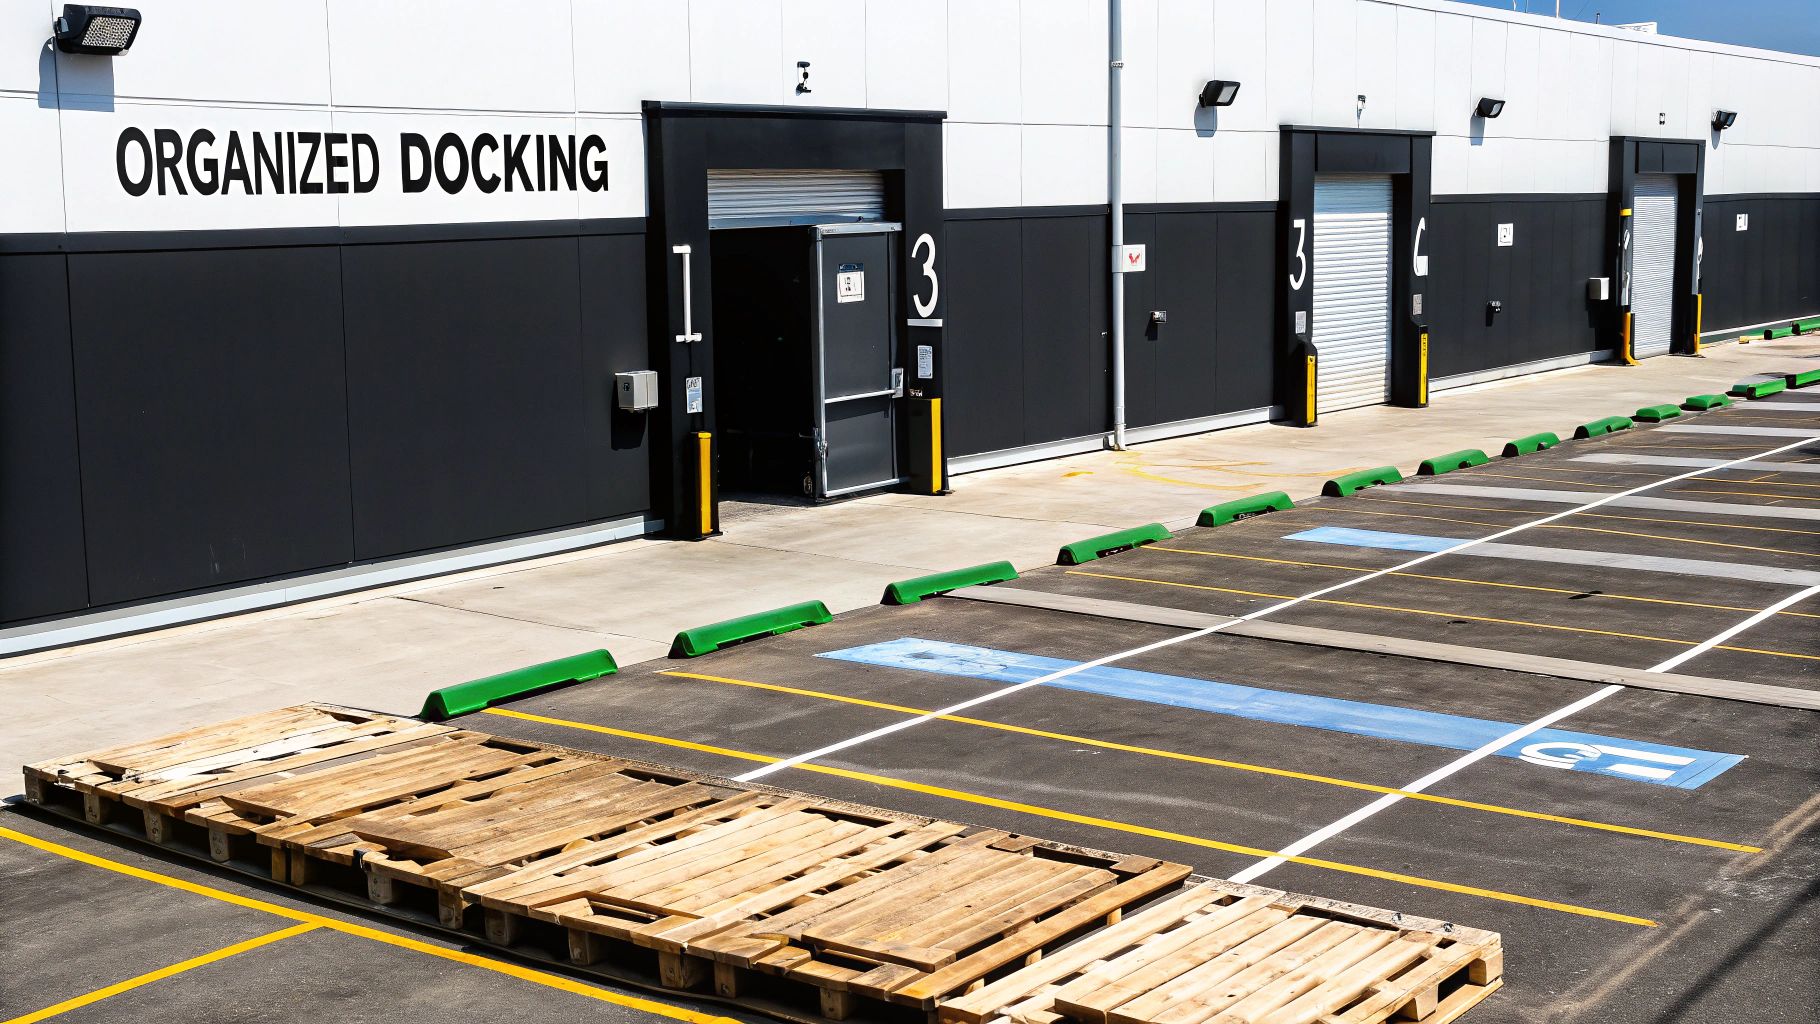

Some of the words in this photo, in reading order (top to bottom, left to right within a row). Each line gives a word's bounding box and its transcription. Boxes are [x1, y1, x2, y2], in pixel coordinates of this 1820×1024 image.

[116, 126, 379, 197] ORGANIZED
[400, 132, 609, 195] DOCKING
[911, 232, 939, 318] 3
[1289, 218, 1307, 291] 3
